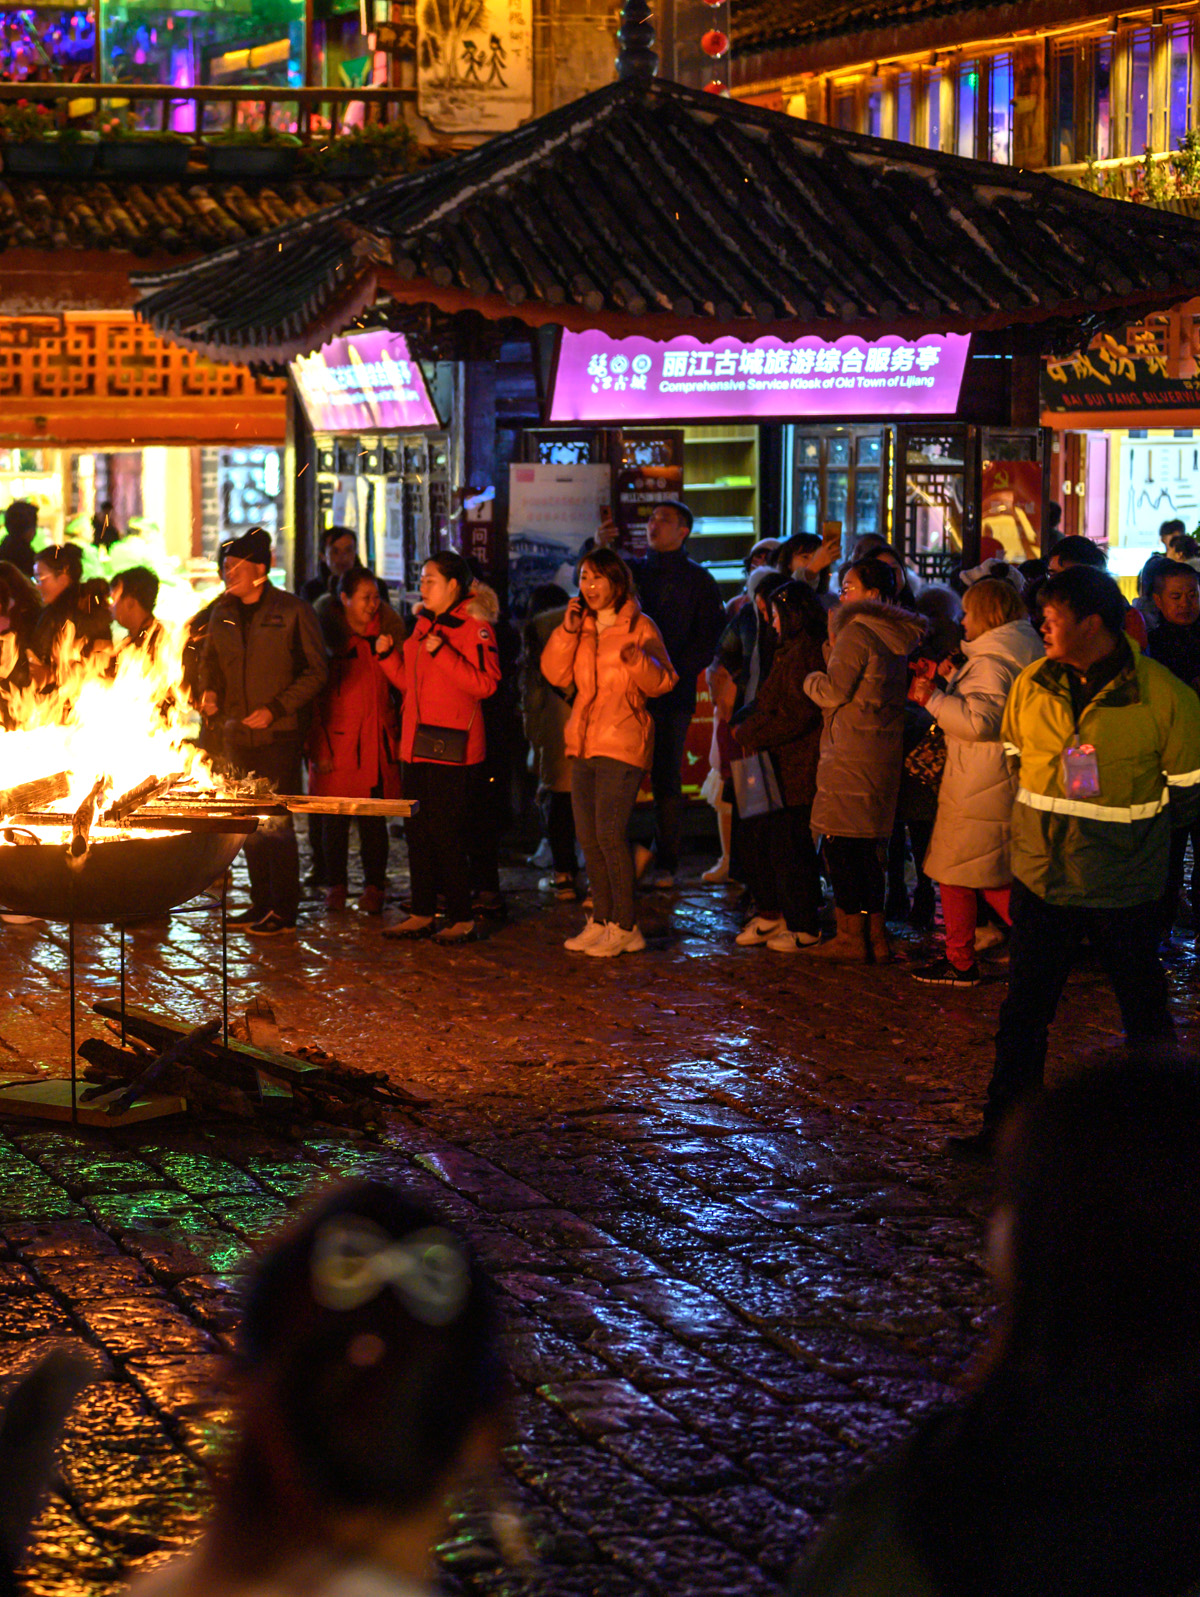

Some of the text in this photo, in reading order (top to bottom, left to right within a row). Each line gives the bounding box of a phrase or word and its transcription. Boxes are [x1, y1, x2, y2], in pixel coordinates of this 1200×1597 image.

[662, 346, 942, 378] 丽江古城旅游综合服务亭
[658, 375, 935, 394] Comprehensive Service Kiosk of Old Town of Lijiang
